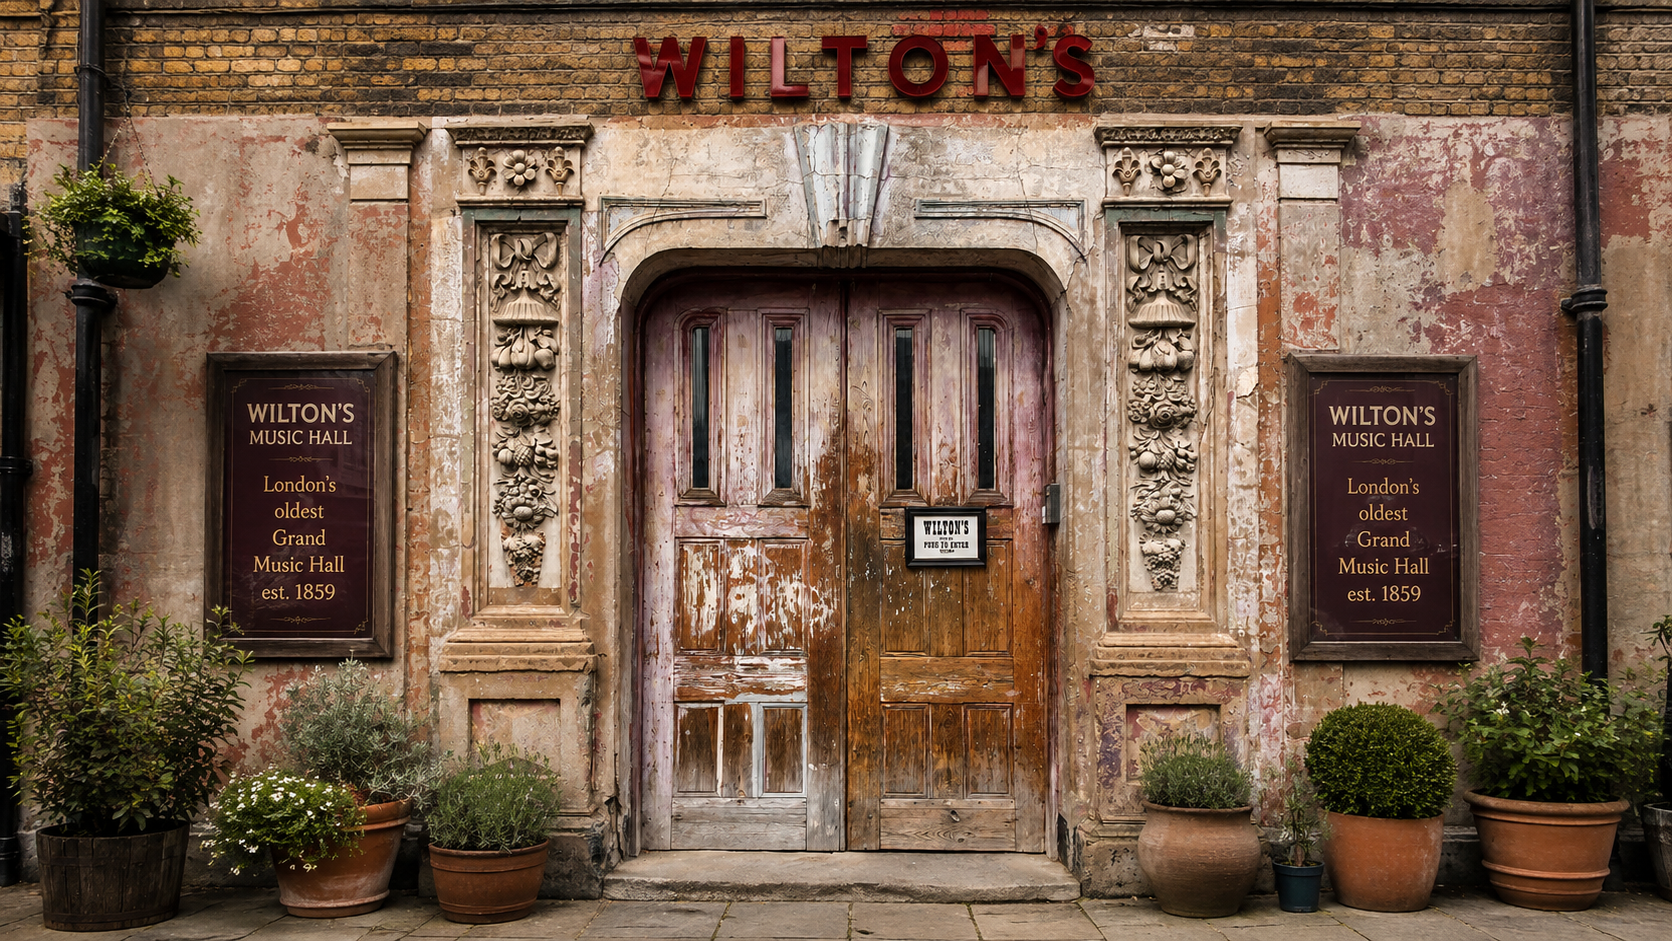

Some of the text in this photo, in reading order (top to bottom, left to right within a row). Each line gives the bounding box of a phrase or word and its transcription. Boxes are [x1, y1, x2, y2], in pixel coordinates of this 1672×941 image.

[633, 24, 1096, 100] WILTON'S
[246, 402, 355, 424] WILTON'S
[1328, 405, 1436, 426] WILTON'S
[249, 429, 353, 445] MUSIC HALL
[1332, 432, 1435, 448] MUSIC HALL
[263, 475, 337, 493] London's
[1347, 477, 1420, 495] London's
[274, 501, 325, 519] oldest
[1358, 503, 1408, 521] oldest
[923, 520, 969, 535] WILTON'S
[272, 528, 326, 546] Grand
[1357, 530, 1411, 548] Grand
[253, 555, 345, 573] Music Hall
[1338, 557, 1430, 575] Music Hall
[261, 583, 336, 601] est. 1859
[1347, 584, 1421, 602] est. 1859
